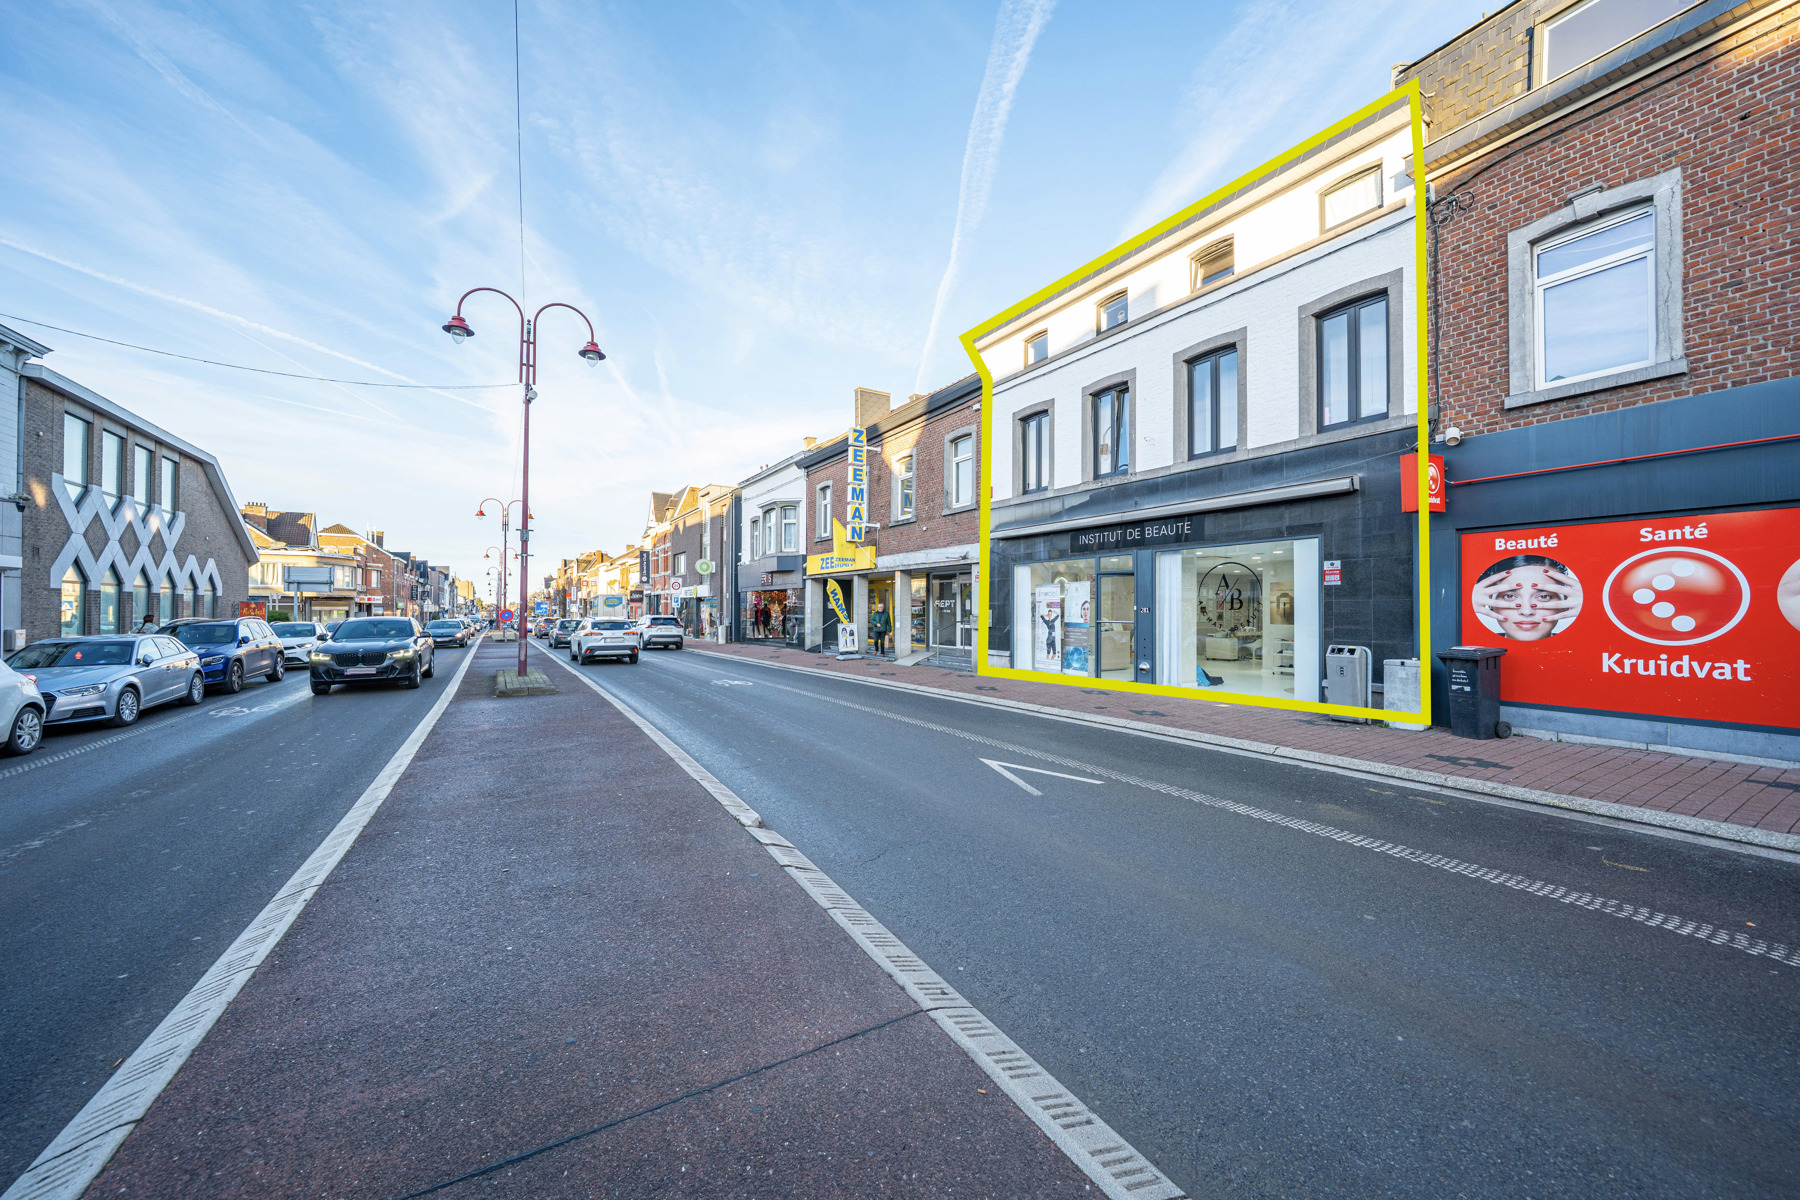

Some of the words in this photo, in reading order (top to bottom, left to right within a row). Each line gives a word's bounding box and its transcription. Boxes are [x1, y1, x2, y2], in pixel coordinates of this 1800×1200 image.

[851, 429, 865, 541] ZEEMAN
[1079, 530, 1123, 545] INSTITUT
[1126, 528, 1141, 540] DE
[1495, 533, 1558, 551] Beauté
[1639, 522, 1708, 542] Santé
[1602, 652, 1752, 682] Kruidvat
